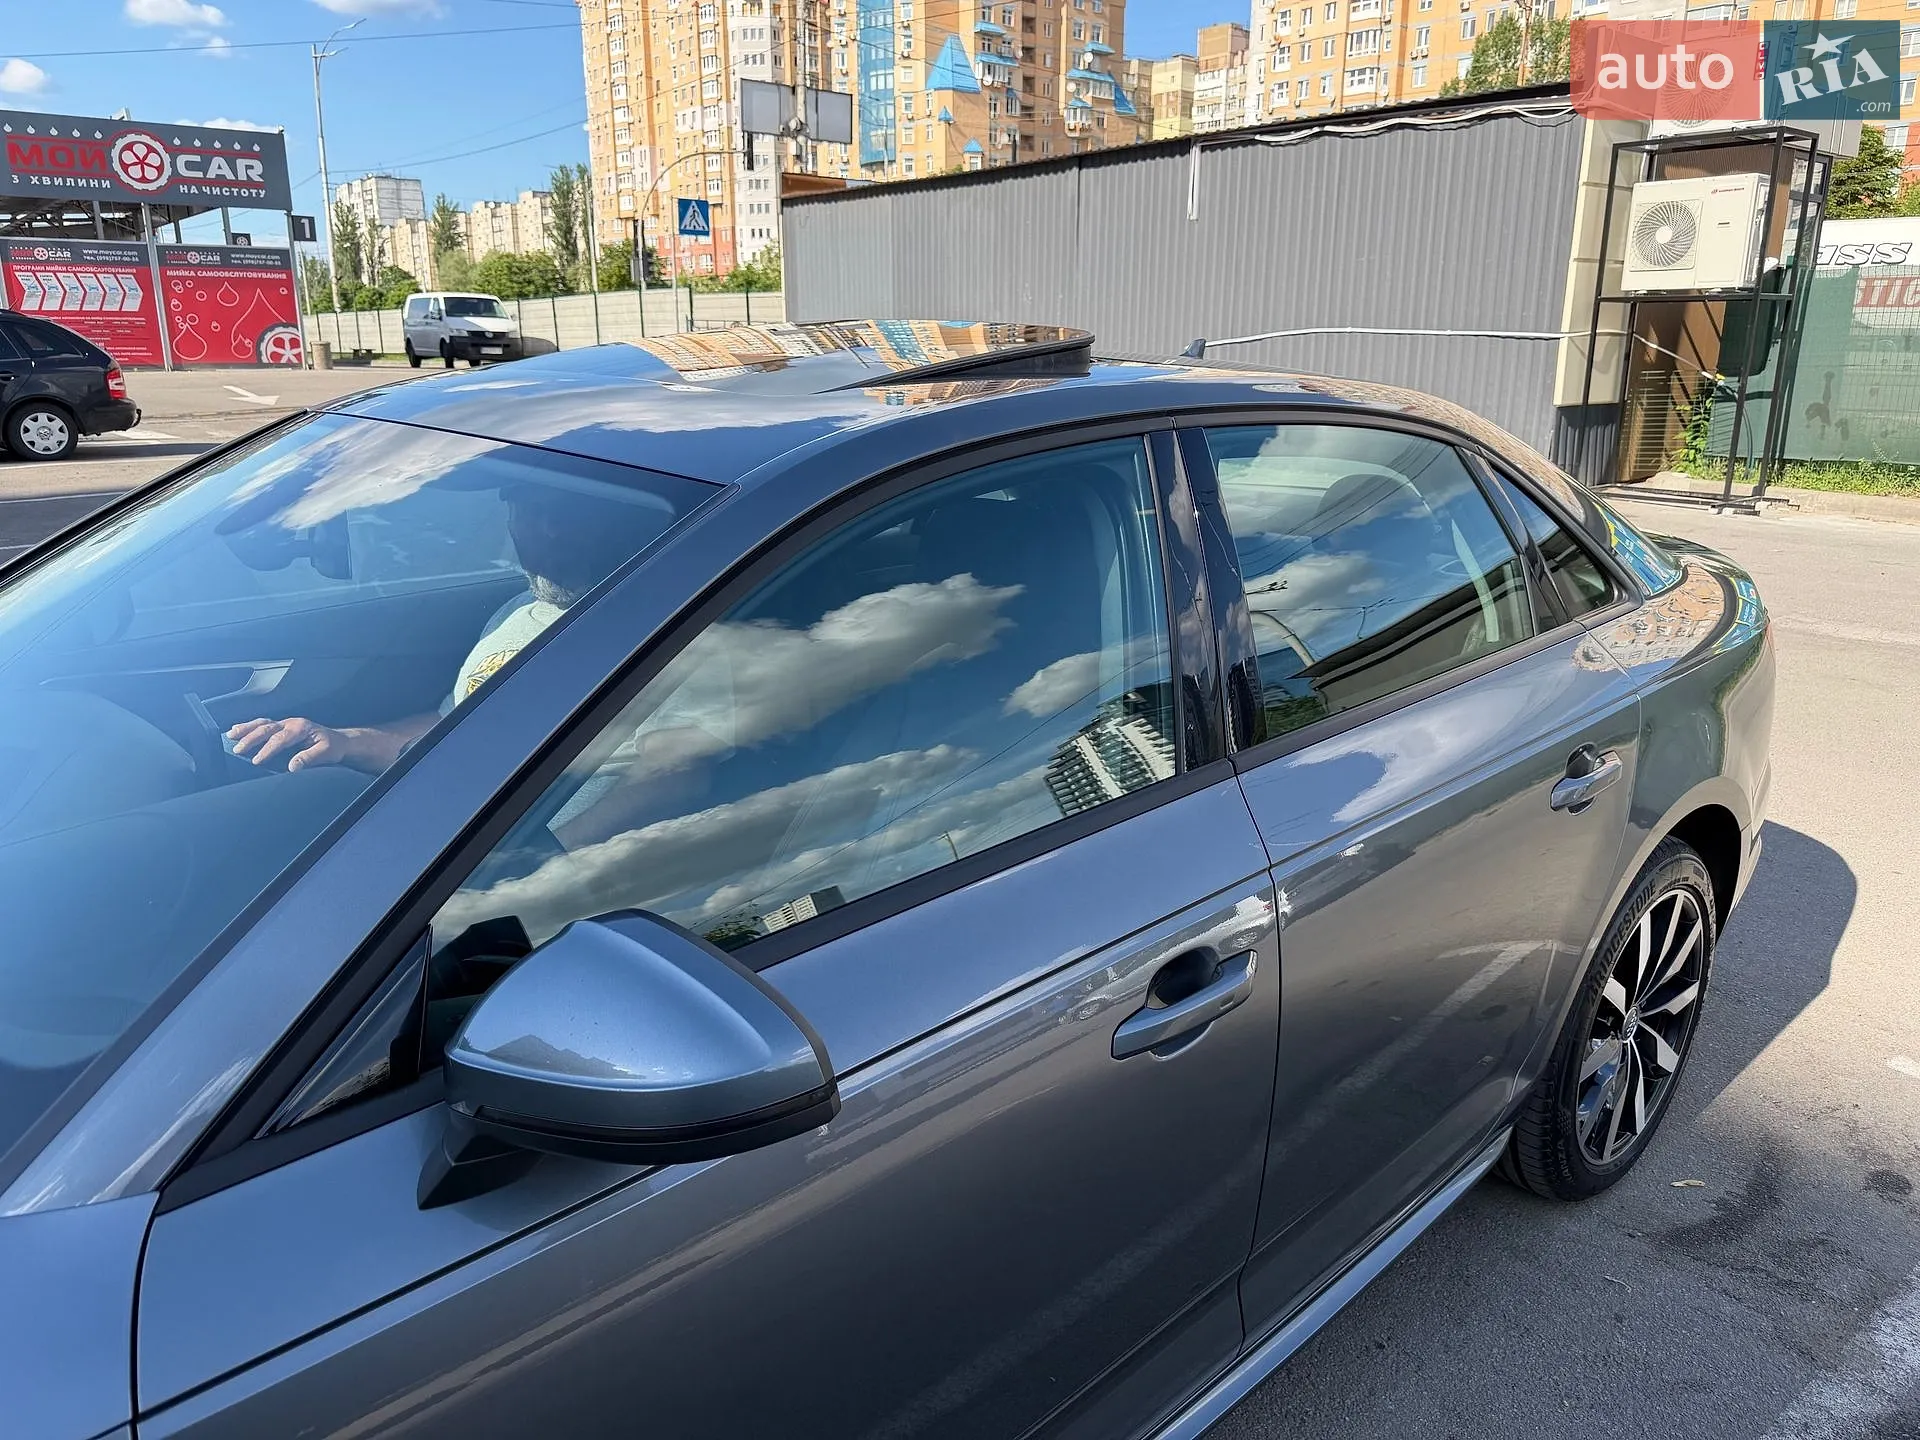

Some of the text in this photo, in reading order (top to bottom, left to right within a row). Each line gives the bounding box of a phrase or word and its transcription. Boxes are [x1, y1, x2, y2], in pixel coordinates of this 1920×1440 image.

[176, 154, 264, 182] CAR
[30, 175, 111, 188] ХВИЛИНИ
[300, 218, 310, 239] 1
[48, 250, 71, 258] CAR
[166, 269, 196, 277] МИЙКА
